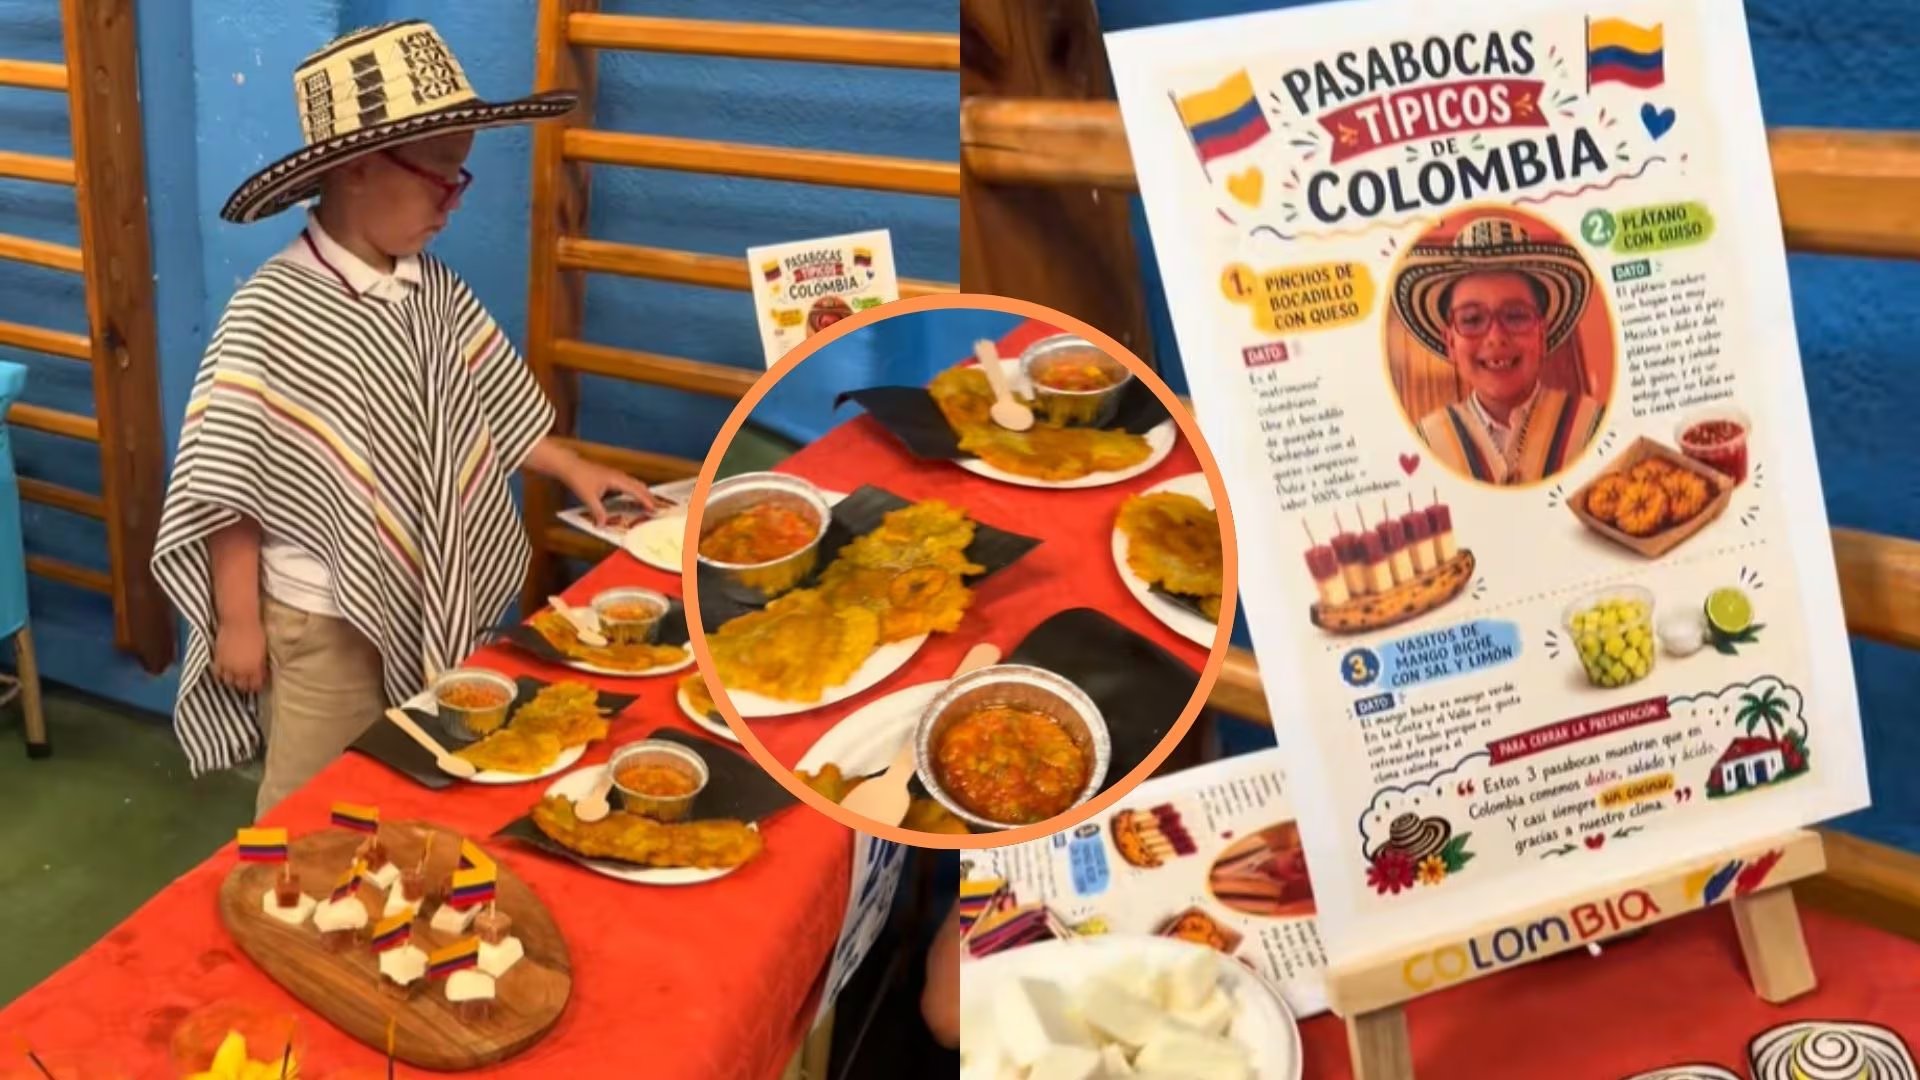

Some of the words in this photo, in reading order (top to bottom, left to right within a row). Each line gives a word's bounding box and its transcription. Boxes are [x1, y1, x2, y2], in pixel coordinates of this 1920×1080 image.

[1282, 30, 1535, 116] PASABOCAS
[1356, 84, 1511, 143] TÍPICOS
[1431, 138, 1459, 157] DE
[1308, 127, 1608, 223] COLOMBIA
[1588, 214, 1611, 240] 2.
[1622, 207, 1686, 231] PLÁTANO
[1624, 231, 1653, 248] CON
[1660, 222, 1702, 241] GUISO
[785, 249, 842, 270] PASABOCAS
[789, 276, 858, 299] COLOMBIA
[1231, 270, 1252, 296] 1.
[1265, 268, 1330, 292] PINCHOS
[1335, 264, 1353, 280] DE
[1270, 283, 1353, 311] BOCADILLO
[1274, 312, 1306, 330] CON
[1310, 302, 1358, 324] QUESO
[1395, 647, 1448, 670] MANGO
[1454, 635, 1495, 654] BICHE
[1396, 626, 1456, 653] VASITOS
[1461, 624, 1479, 638] DE
[1349, 654, 1375, 680] 3.
[1392, 670, 1420, 686] CON
[1425, 662, 1448, 678] SAL
[1456, 659, 1463, 670] Y
[1364, 732, 1378, 744] En
[1382, 727, 1391, 738] la
[1394, 721, 1422, 735] Costa
[1426, 718, 1433, 729] y
[1437, 713, 1445, 724] el
[1448, 706, 1471, 720] Valle
[1476, 704, 1491, 714] nos
[1495, 695, 1521, 711] gusta
[1375, 710, 1407, 725] mango
[1410, 703, 1435, 716] biche
[1454, 690, 1485, 705] mango
[1368, 745, 1385, 757] con
[1389, 738, 1403, 750] sal
[1406, 739, 1412, 749] y
[1445, 720, 1477, 741] porque
[1481, 718, 1491, 727] es
[1429, 743, 1450, 757] para
[1454, 738, 1462, 748] el
[1500, 740, 1527, 757] PARA
[1530, 727, 1569, 748] CERRAR
[1572, 722, 1586, 736] LA
[1483, 774, 1520, 794] Estos
[1526, 765, 1537, 782] 3
[1543, 754, 1600, 782] pasabocas
[1605, 738, 1658, 759] muestran
[1662, 731, 1682, 748] que
[1688, 726, 1702, 737] en
[1469, 794, 1525, 819] Colombia
[1529, 779, 1581, 800] comemos
[1627, 754, 1664, 776] salado
[1670, 755, 1677, 767] y
[1507, 815, 1517, 832] Y
[1523, 812, 1546, 828] casi
[1552, 798, 1596, 819] siempre
[1603, 790, 1622, 805] sin
[1515, 830, 1559, 856] gracias
[1565, 826, 1572, 836] a
[1579, 810, 1625, 831] nuestro
